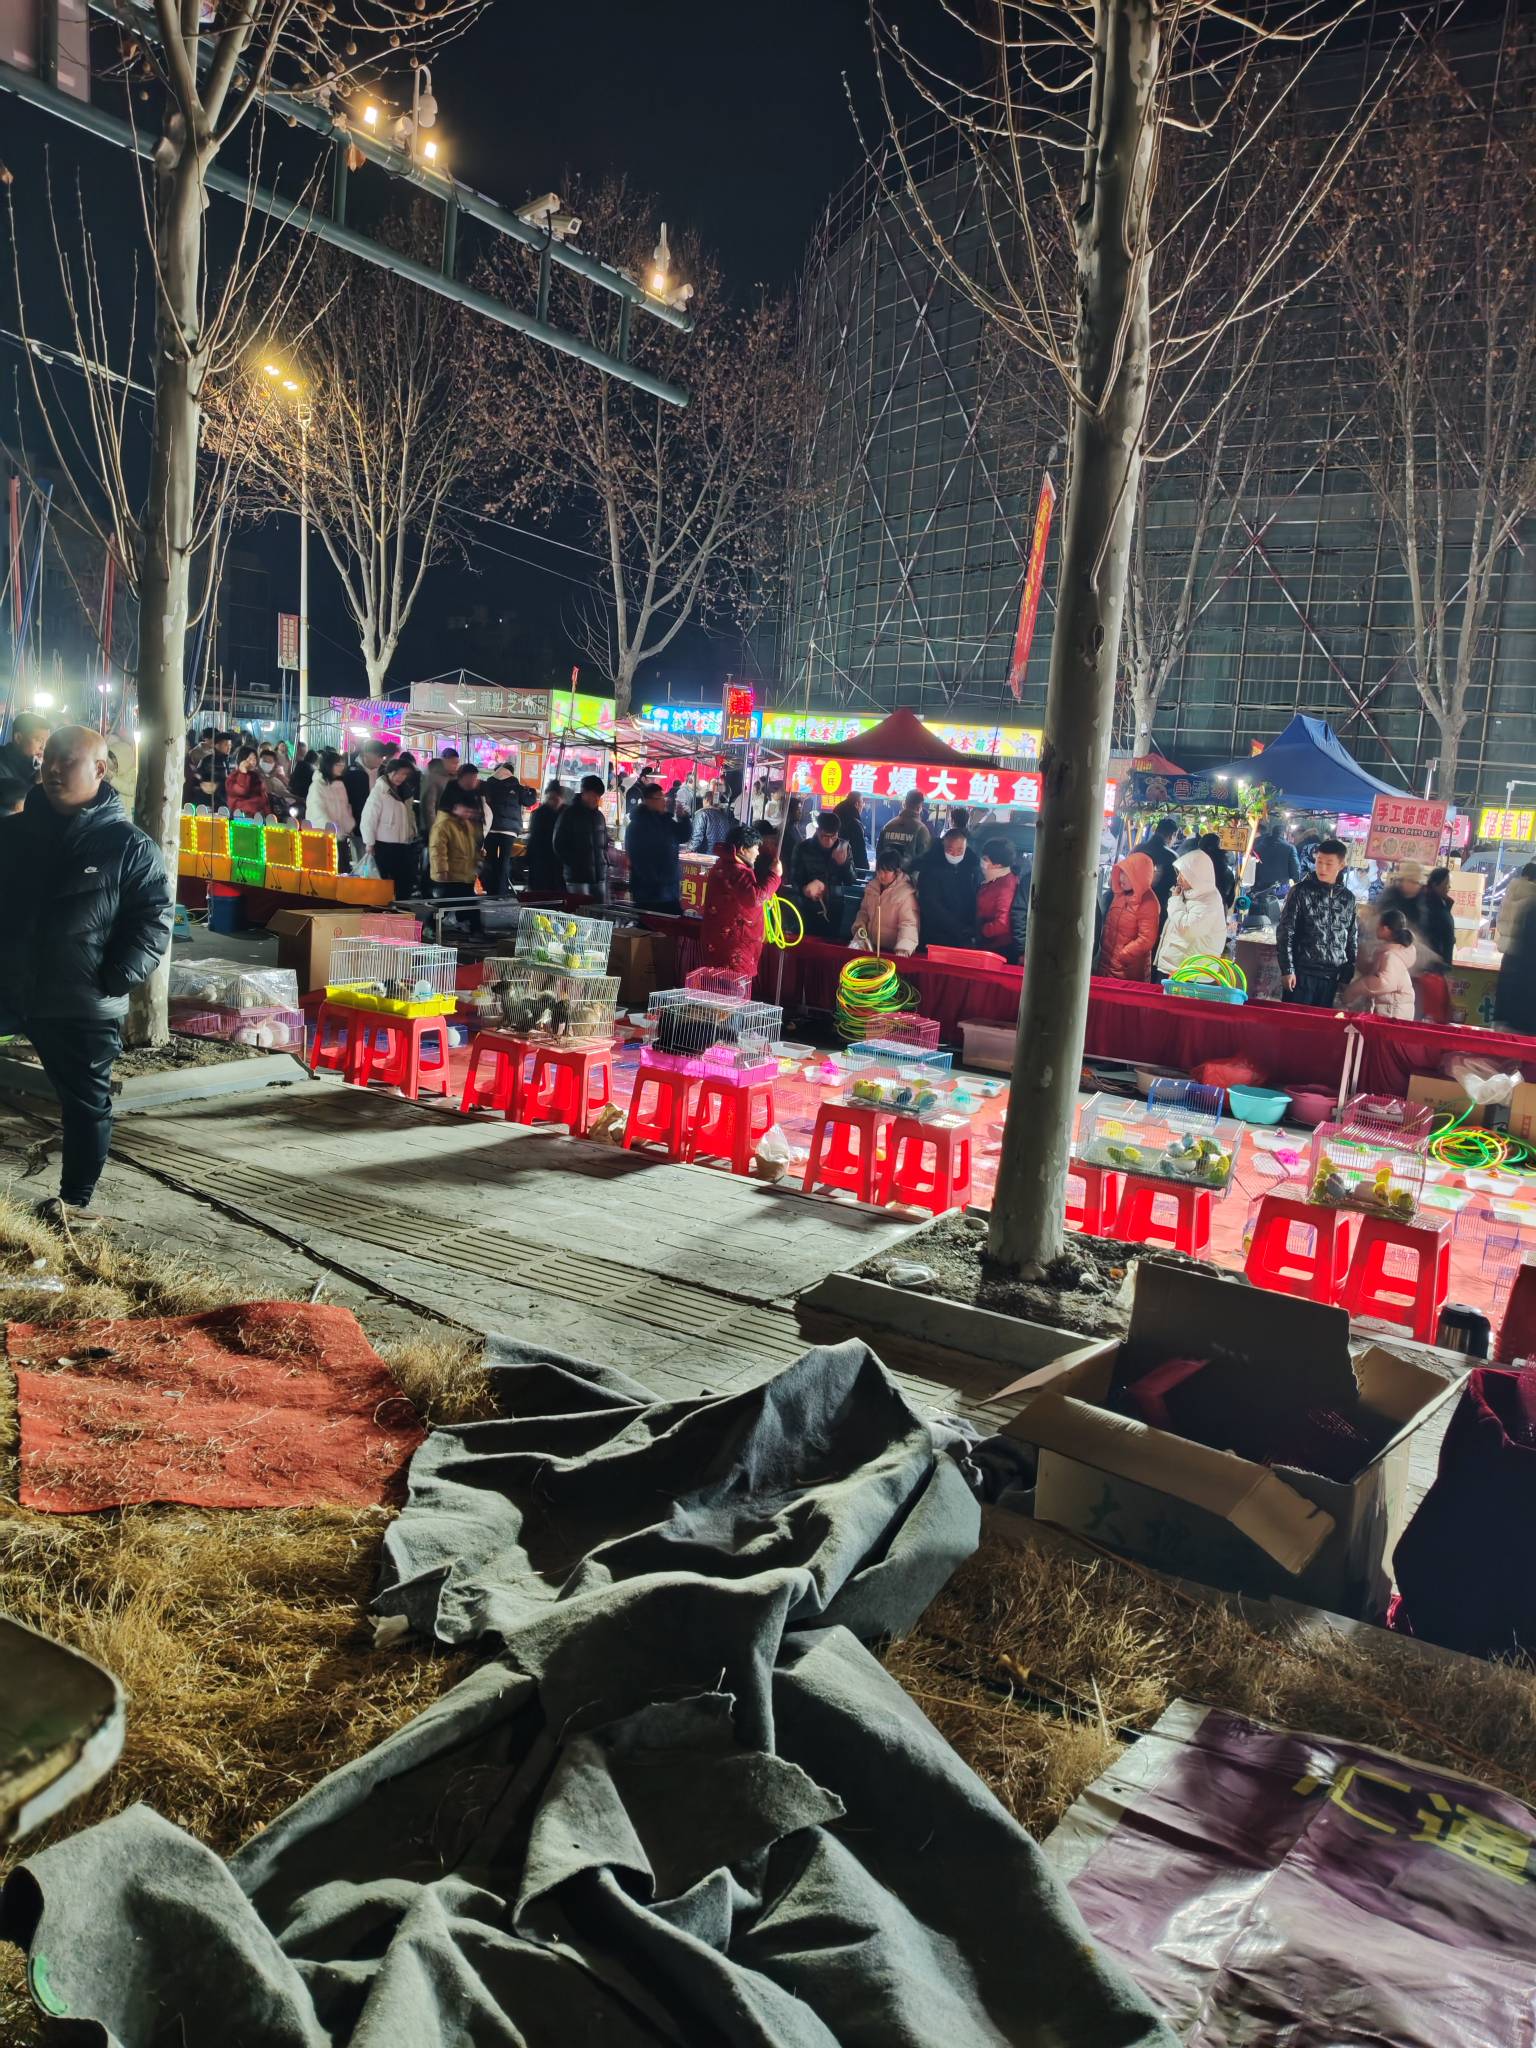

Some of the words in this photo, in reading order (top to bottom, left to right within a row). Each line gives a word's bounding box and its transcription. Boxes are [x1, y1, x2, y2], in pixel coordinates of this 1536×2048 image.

[849, 763, 1040, 807] 酱爆大鱿鱼
[885, 831, 914, 842] RENEW
